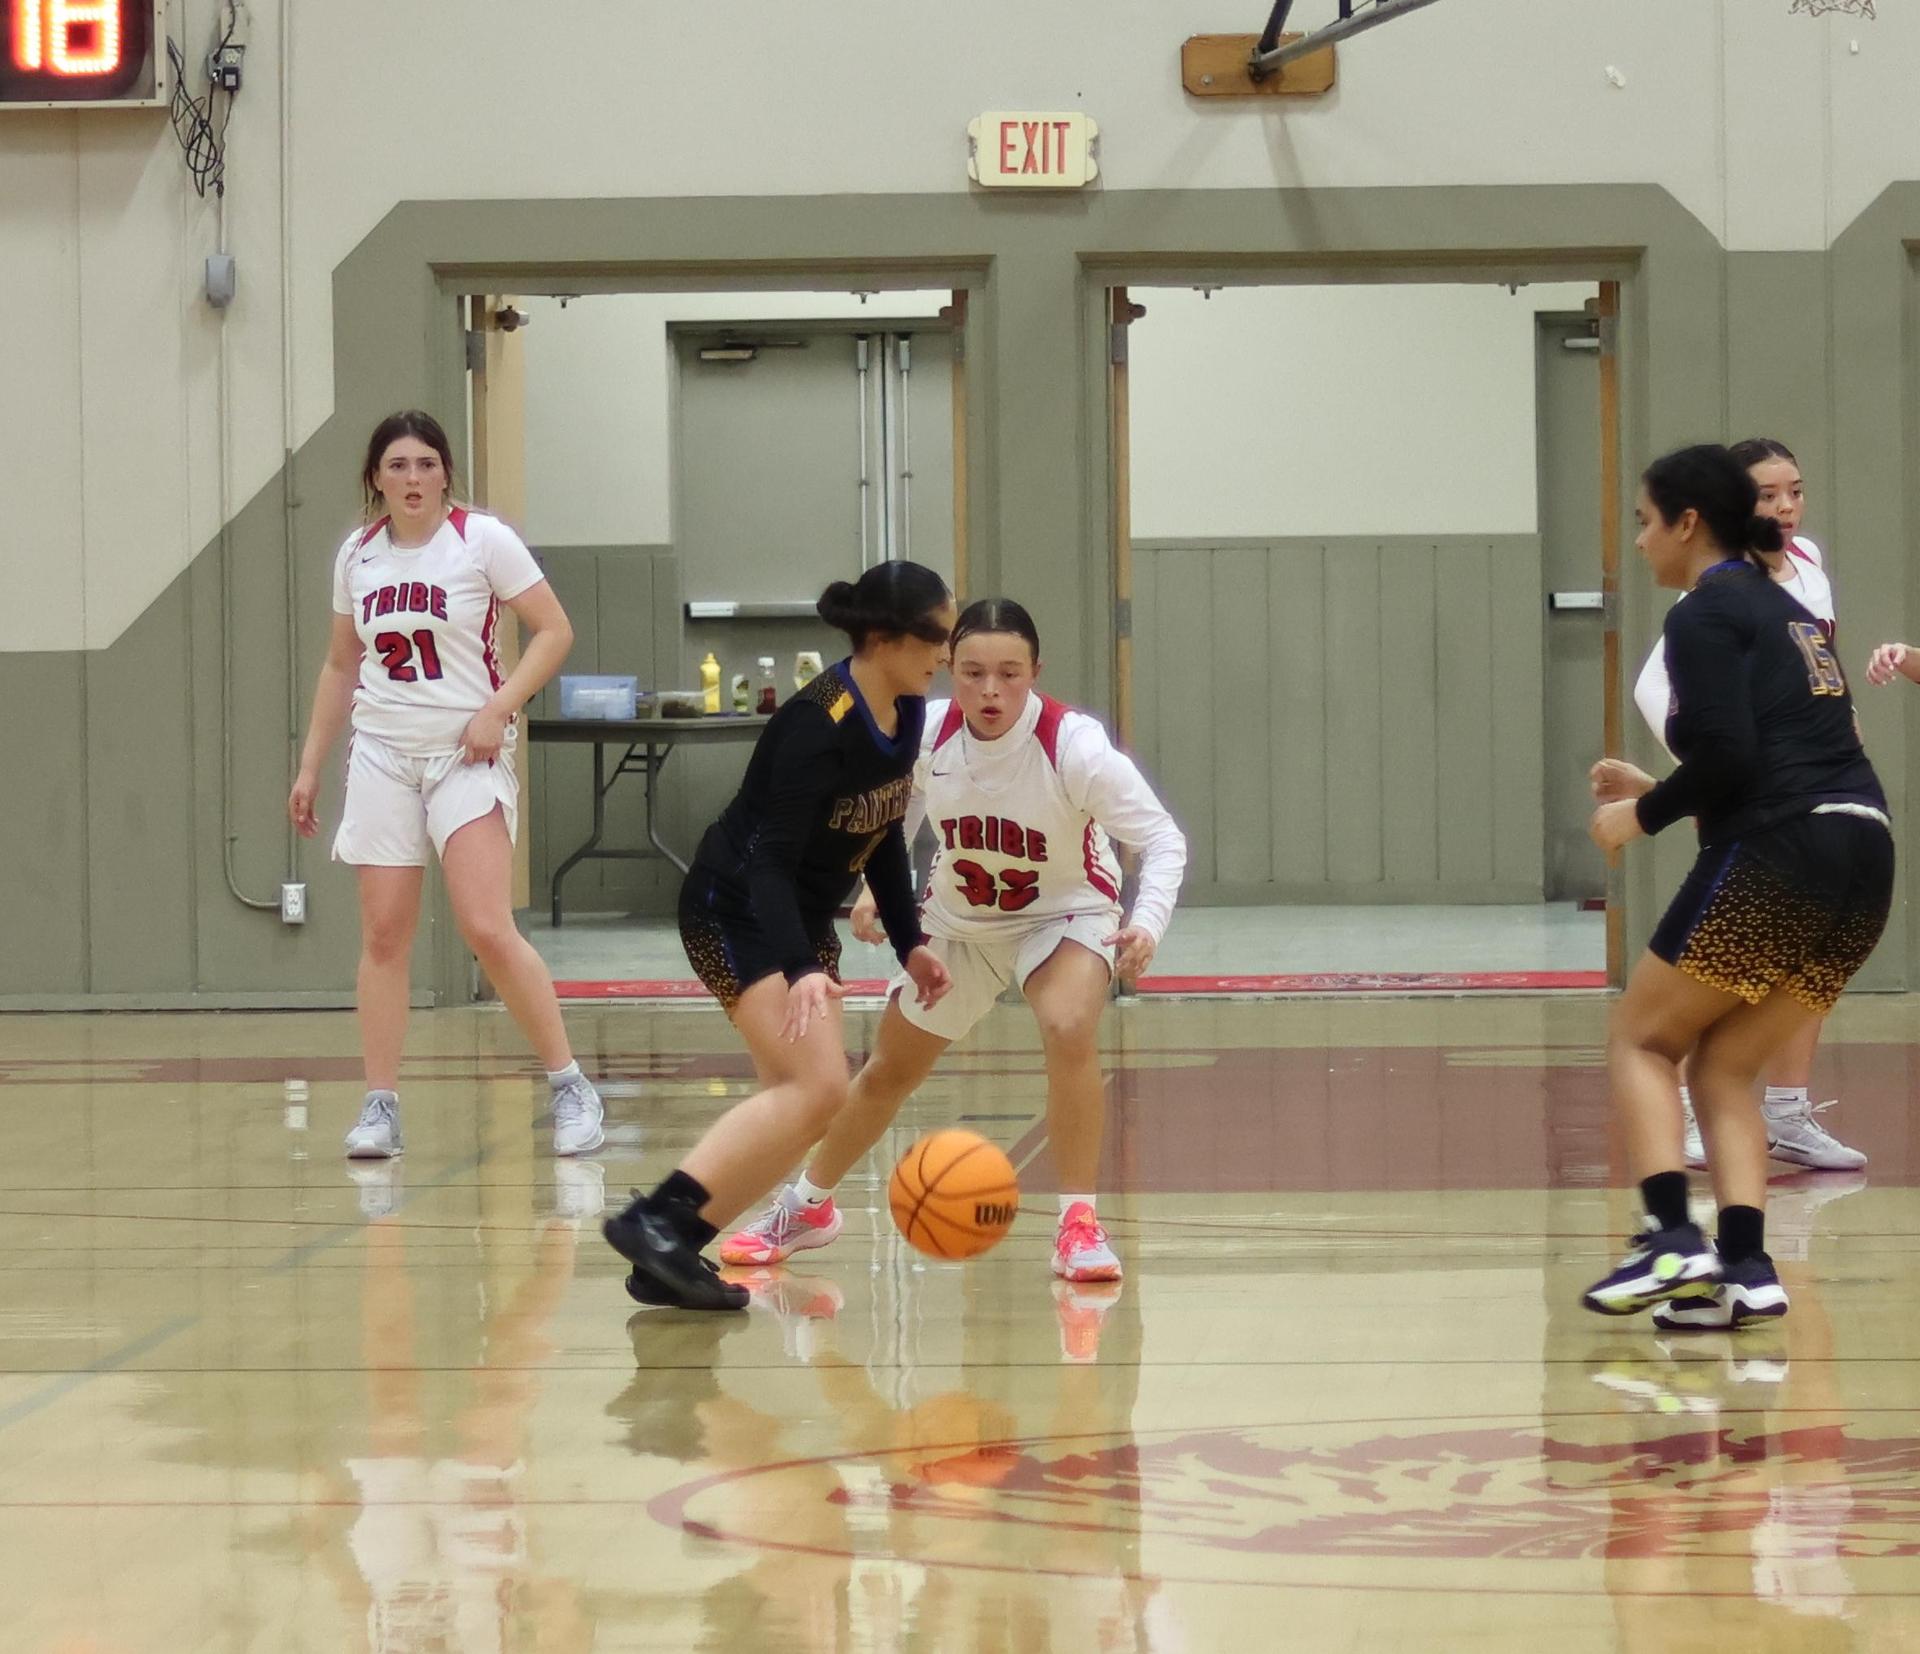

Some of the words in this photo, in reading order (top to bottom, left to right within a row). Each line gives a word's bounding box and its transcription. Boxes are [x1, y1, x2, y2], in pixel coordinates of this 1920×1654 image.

[1000, 121, 1070, 174] EXIT
[363, 581, 448, 625] TRIBE
[374, 629, 443, 682] 21
[1788, 621, 1844, 696] 15
[940, 815, 1048, 862] TRIBE
[952, 858, 1040, 911] 32
